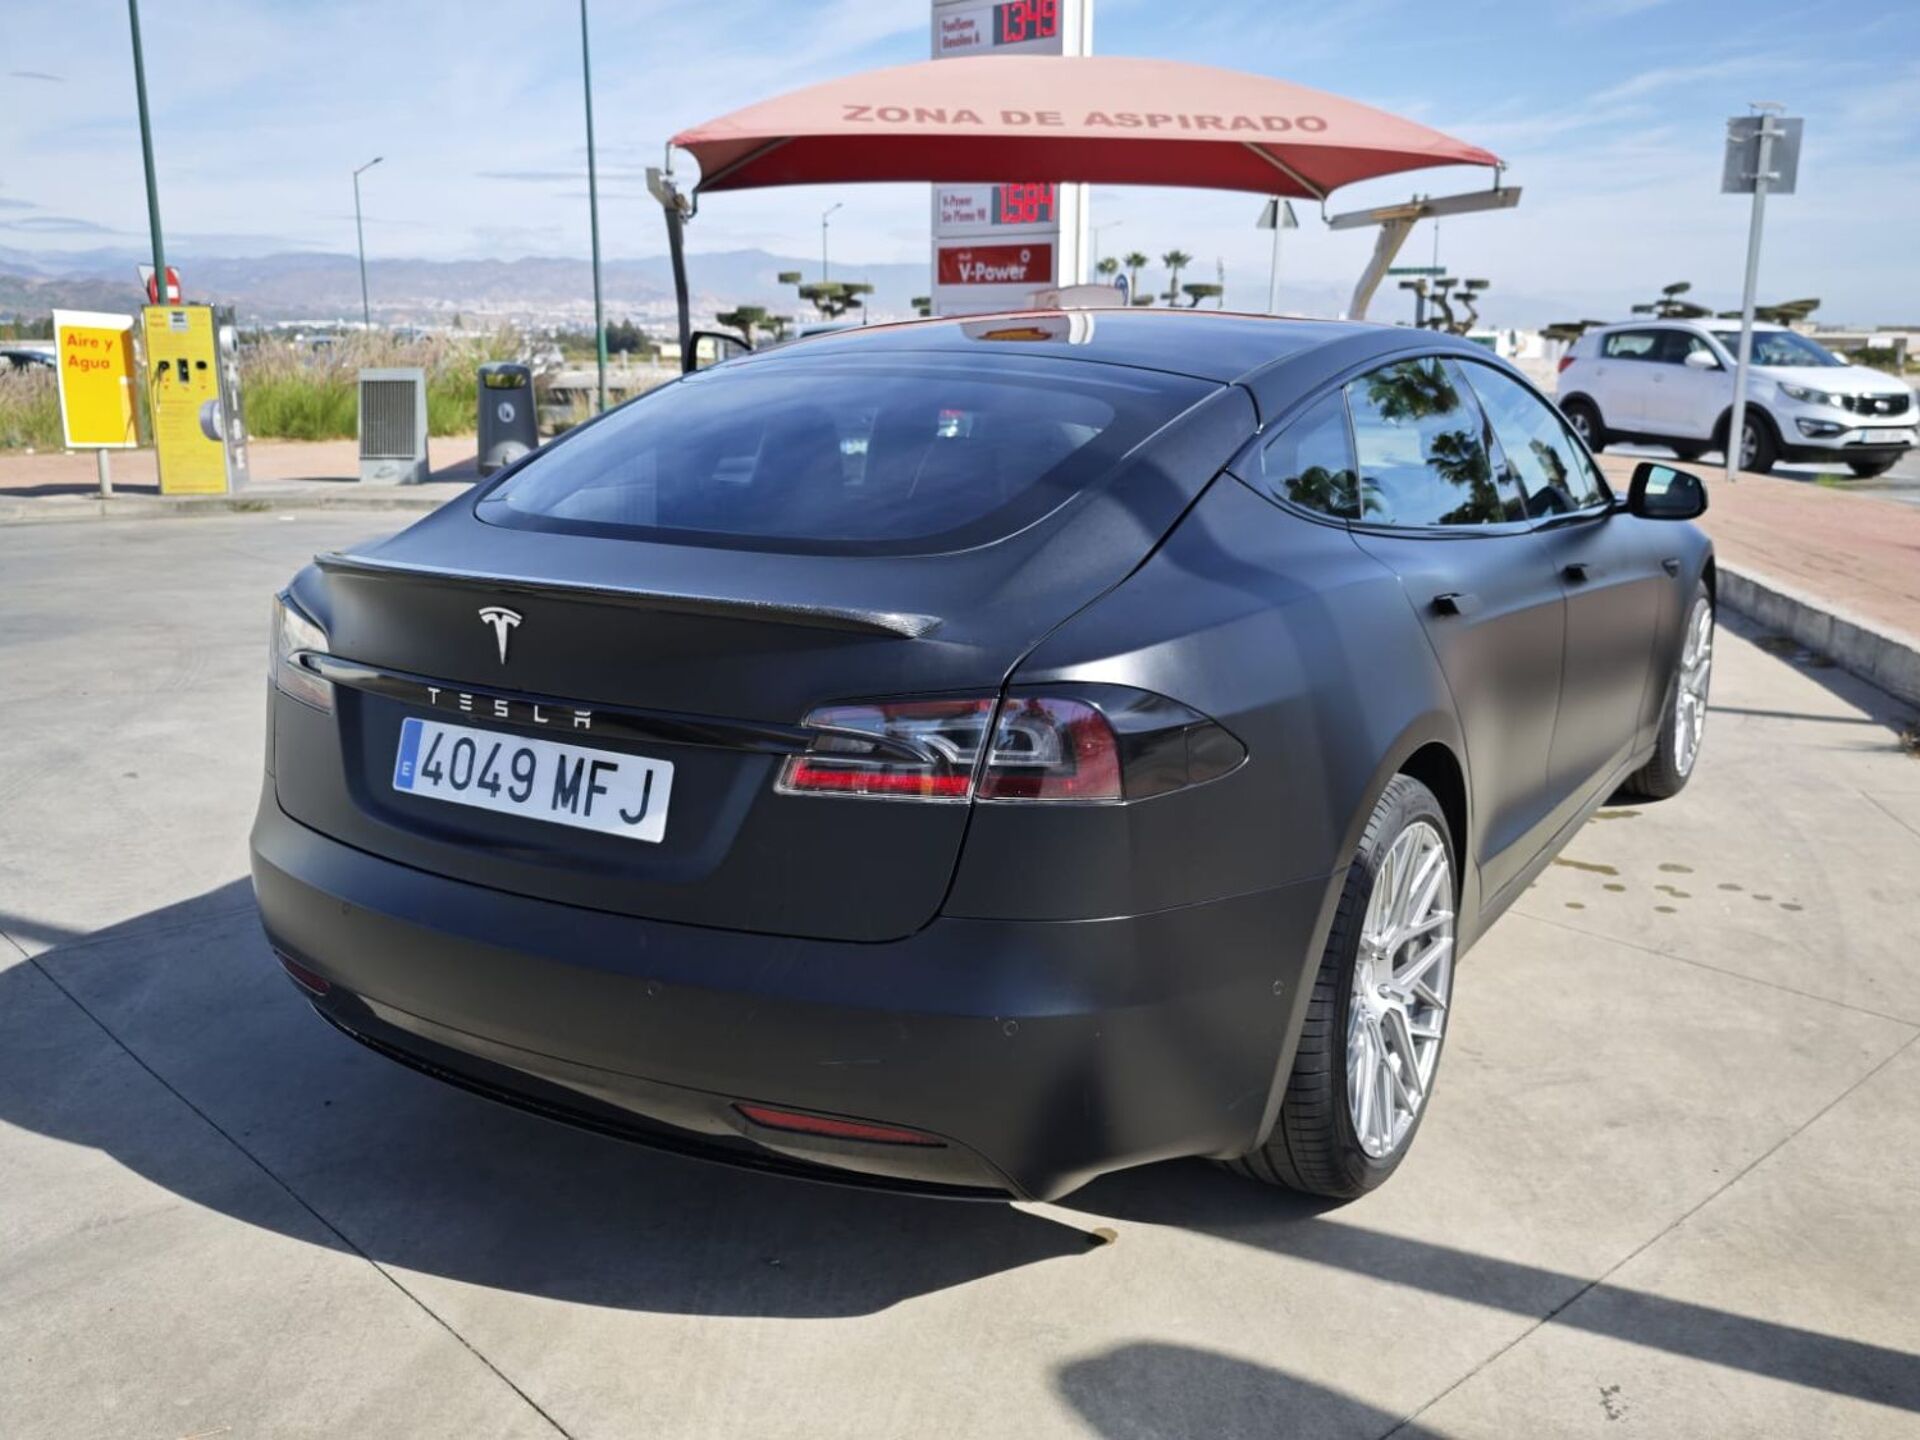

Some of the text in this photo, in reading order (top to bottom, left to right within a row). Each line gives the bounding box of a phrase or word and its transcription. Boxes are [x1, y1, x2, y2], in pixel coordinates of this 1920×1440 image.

[843, 105, 1328, 132] ZONA DE ASPIRADO
[958, 261, 1027, 282] V-Power
[66, 333, 113, 353] Aire y
[68, 354, 110, 373] Agua
[427, 687, 592, 730] TESLA
[401, 760, 412, 777] E
[420, 732, 654, 825] 4049 MFJ
